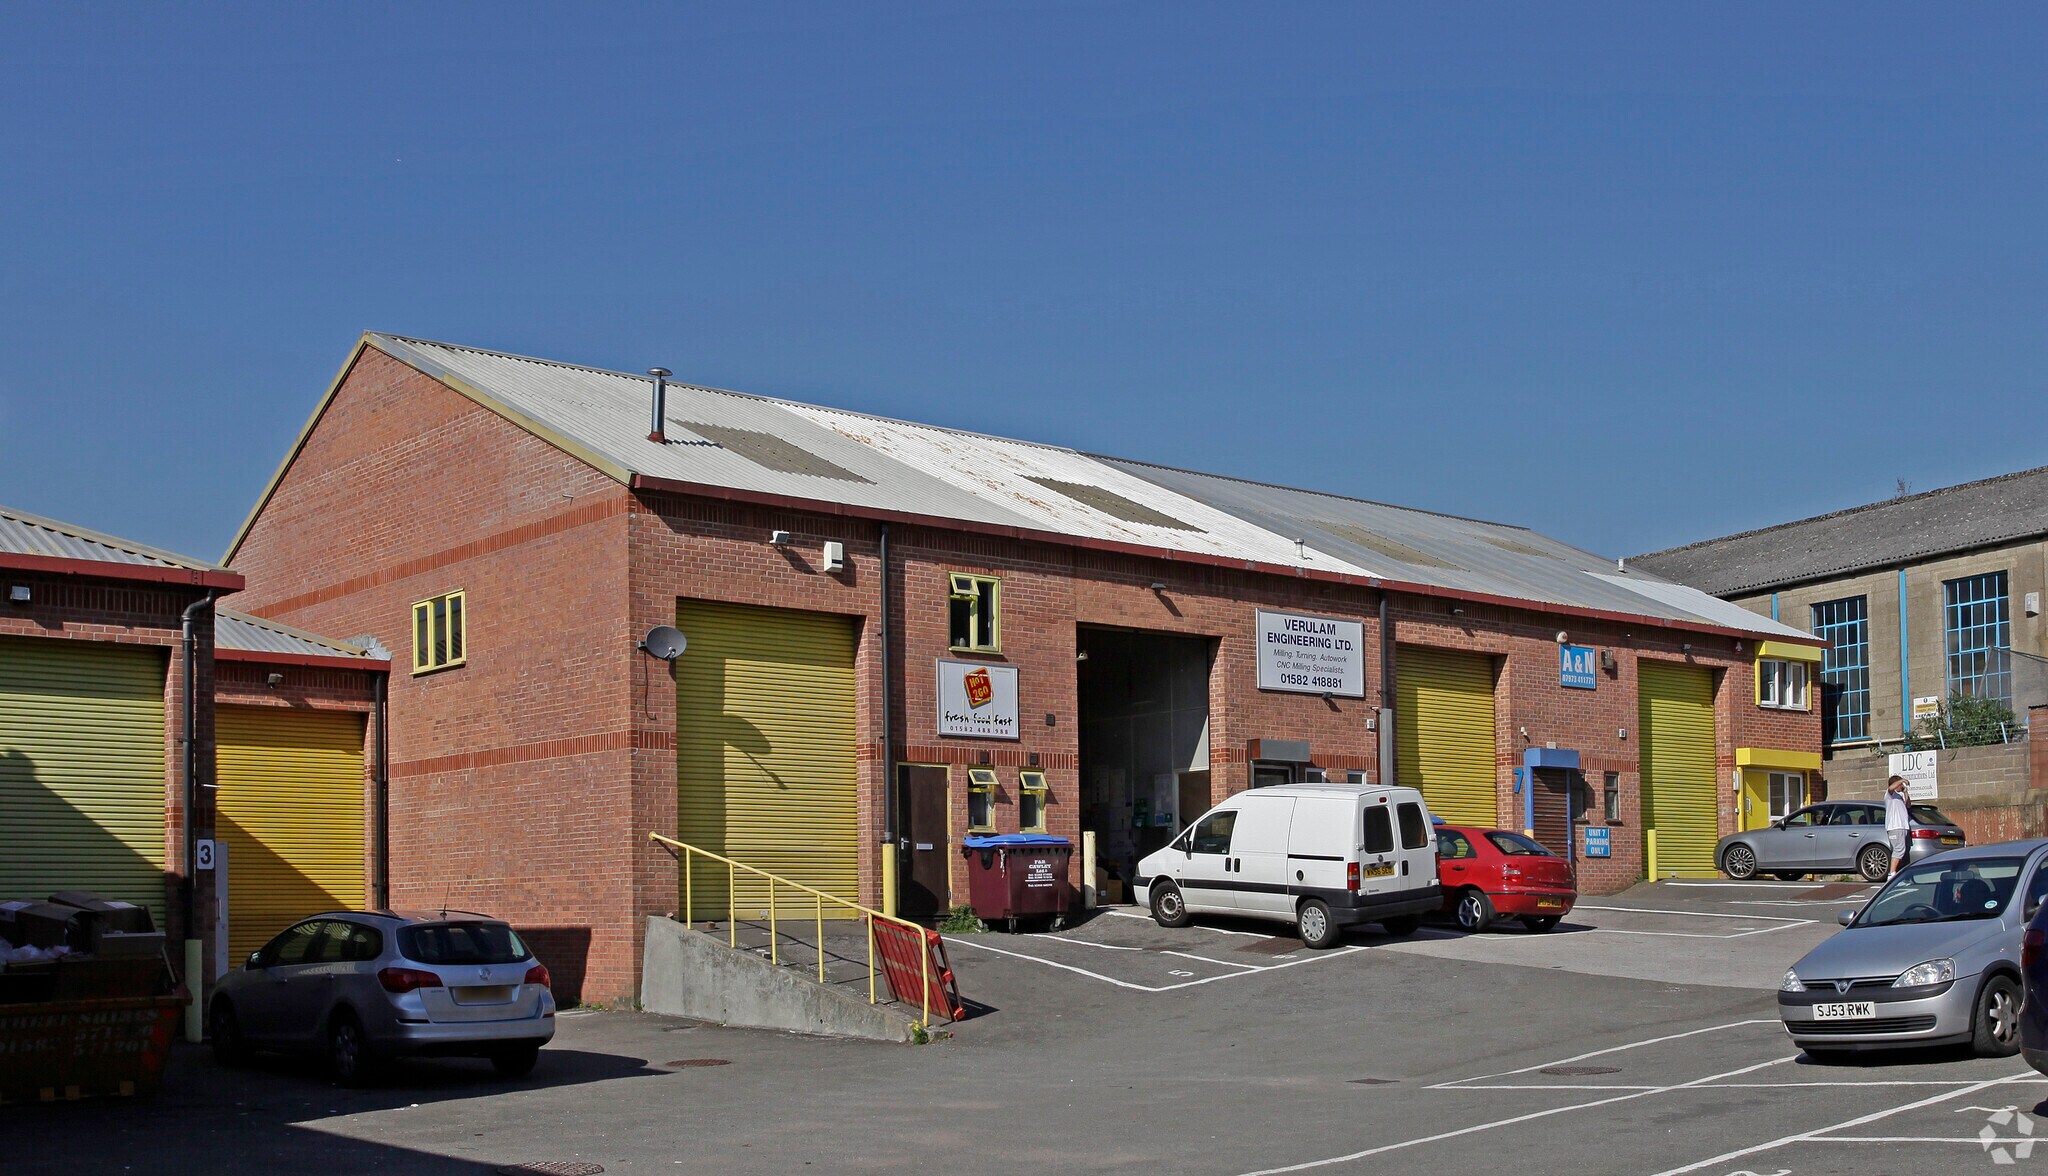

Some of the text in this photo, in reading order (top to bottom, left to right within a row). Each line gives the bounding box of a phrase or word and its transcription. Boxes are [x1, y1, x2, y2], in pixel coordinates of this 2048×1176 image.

[1284, 619, 1336, 635] VERULAM
[1268, 632, 1354, 651] ENGINEERING LTD.
[1320, 654, 1347, 663] Autowork
[1562, 650, 1594, 674] A & N
[1276, 661, 1290, 669] CNC
[1292, 662, 1310, 672] Milling
[969, 676, 984, 688] HOT
[1280, 674, 1342, 688] 01582 418881
[972, 686, 989, 698] 2GO
[945, 711, 1012, 726] fresh food fast
[1902, 753, 1922, 772] LDC
[1514, 768, 1524, 794] 7
[1586, 838, 1608, 846] PARKING
[200, 844, 212, 864] 3
[1590, 846, 1604, 854] ONLY
[1817, 1003, 1870, 1016] SJ53 RWK
